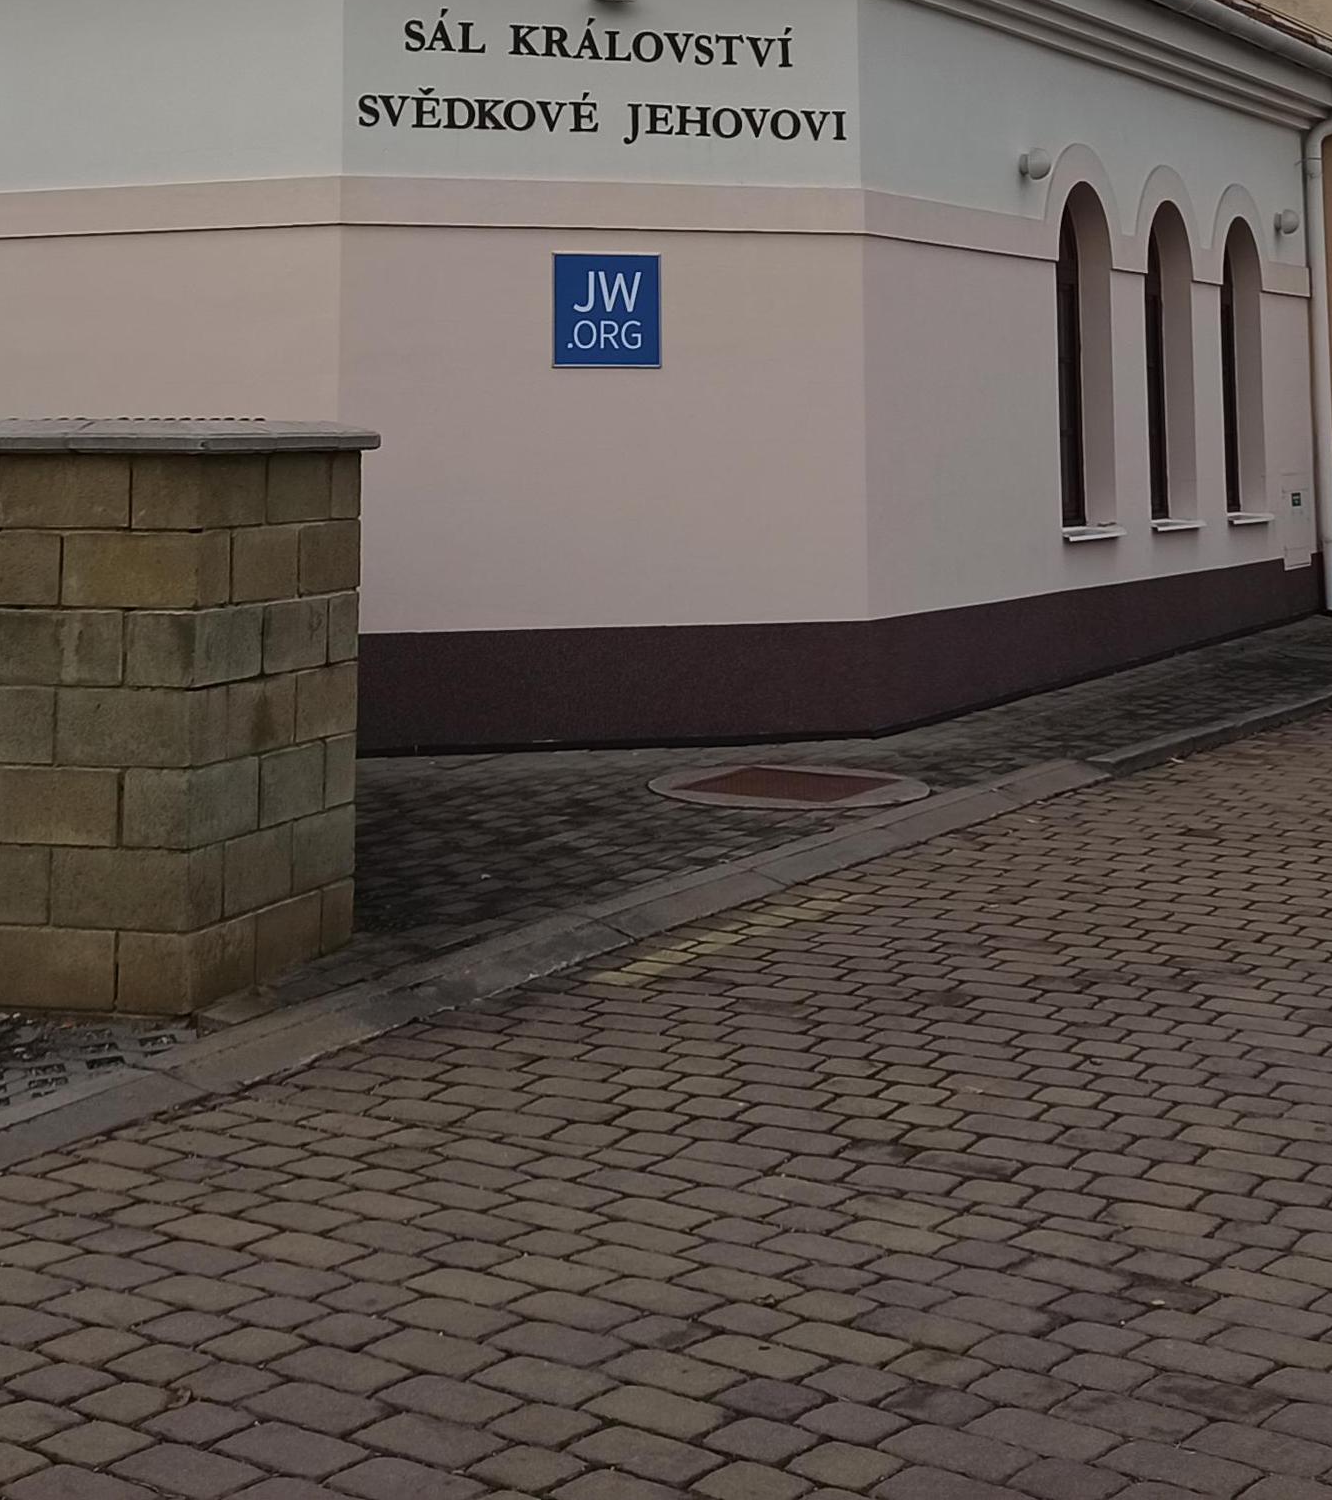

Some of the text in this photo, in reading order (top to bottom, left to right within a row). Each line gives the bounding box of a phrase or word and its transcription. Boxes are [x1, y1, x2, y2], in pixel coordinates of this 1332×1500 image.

[403, 8, 794, 68] SÁL KRÁLOVSTVÍ
[357, 87, 848, 145] SVĚDKOVÉ JEHOVOVI
[572, 270, 642, 313] JW
[566, 319, 643, 349] .ORG
